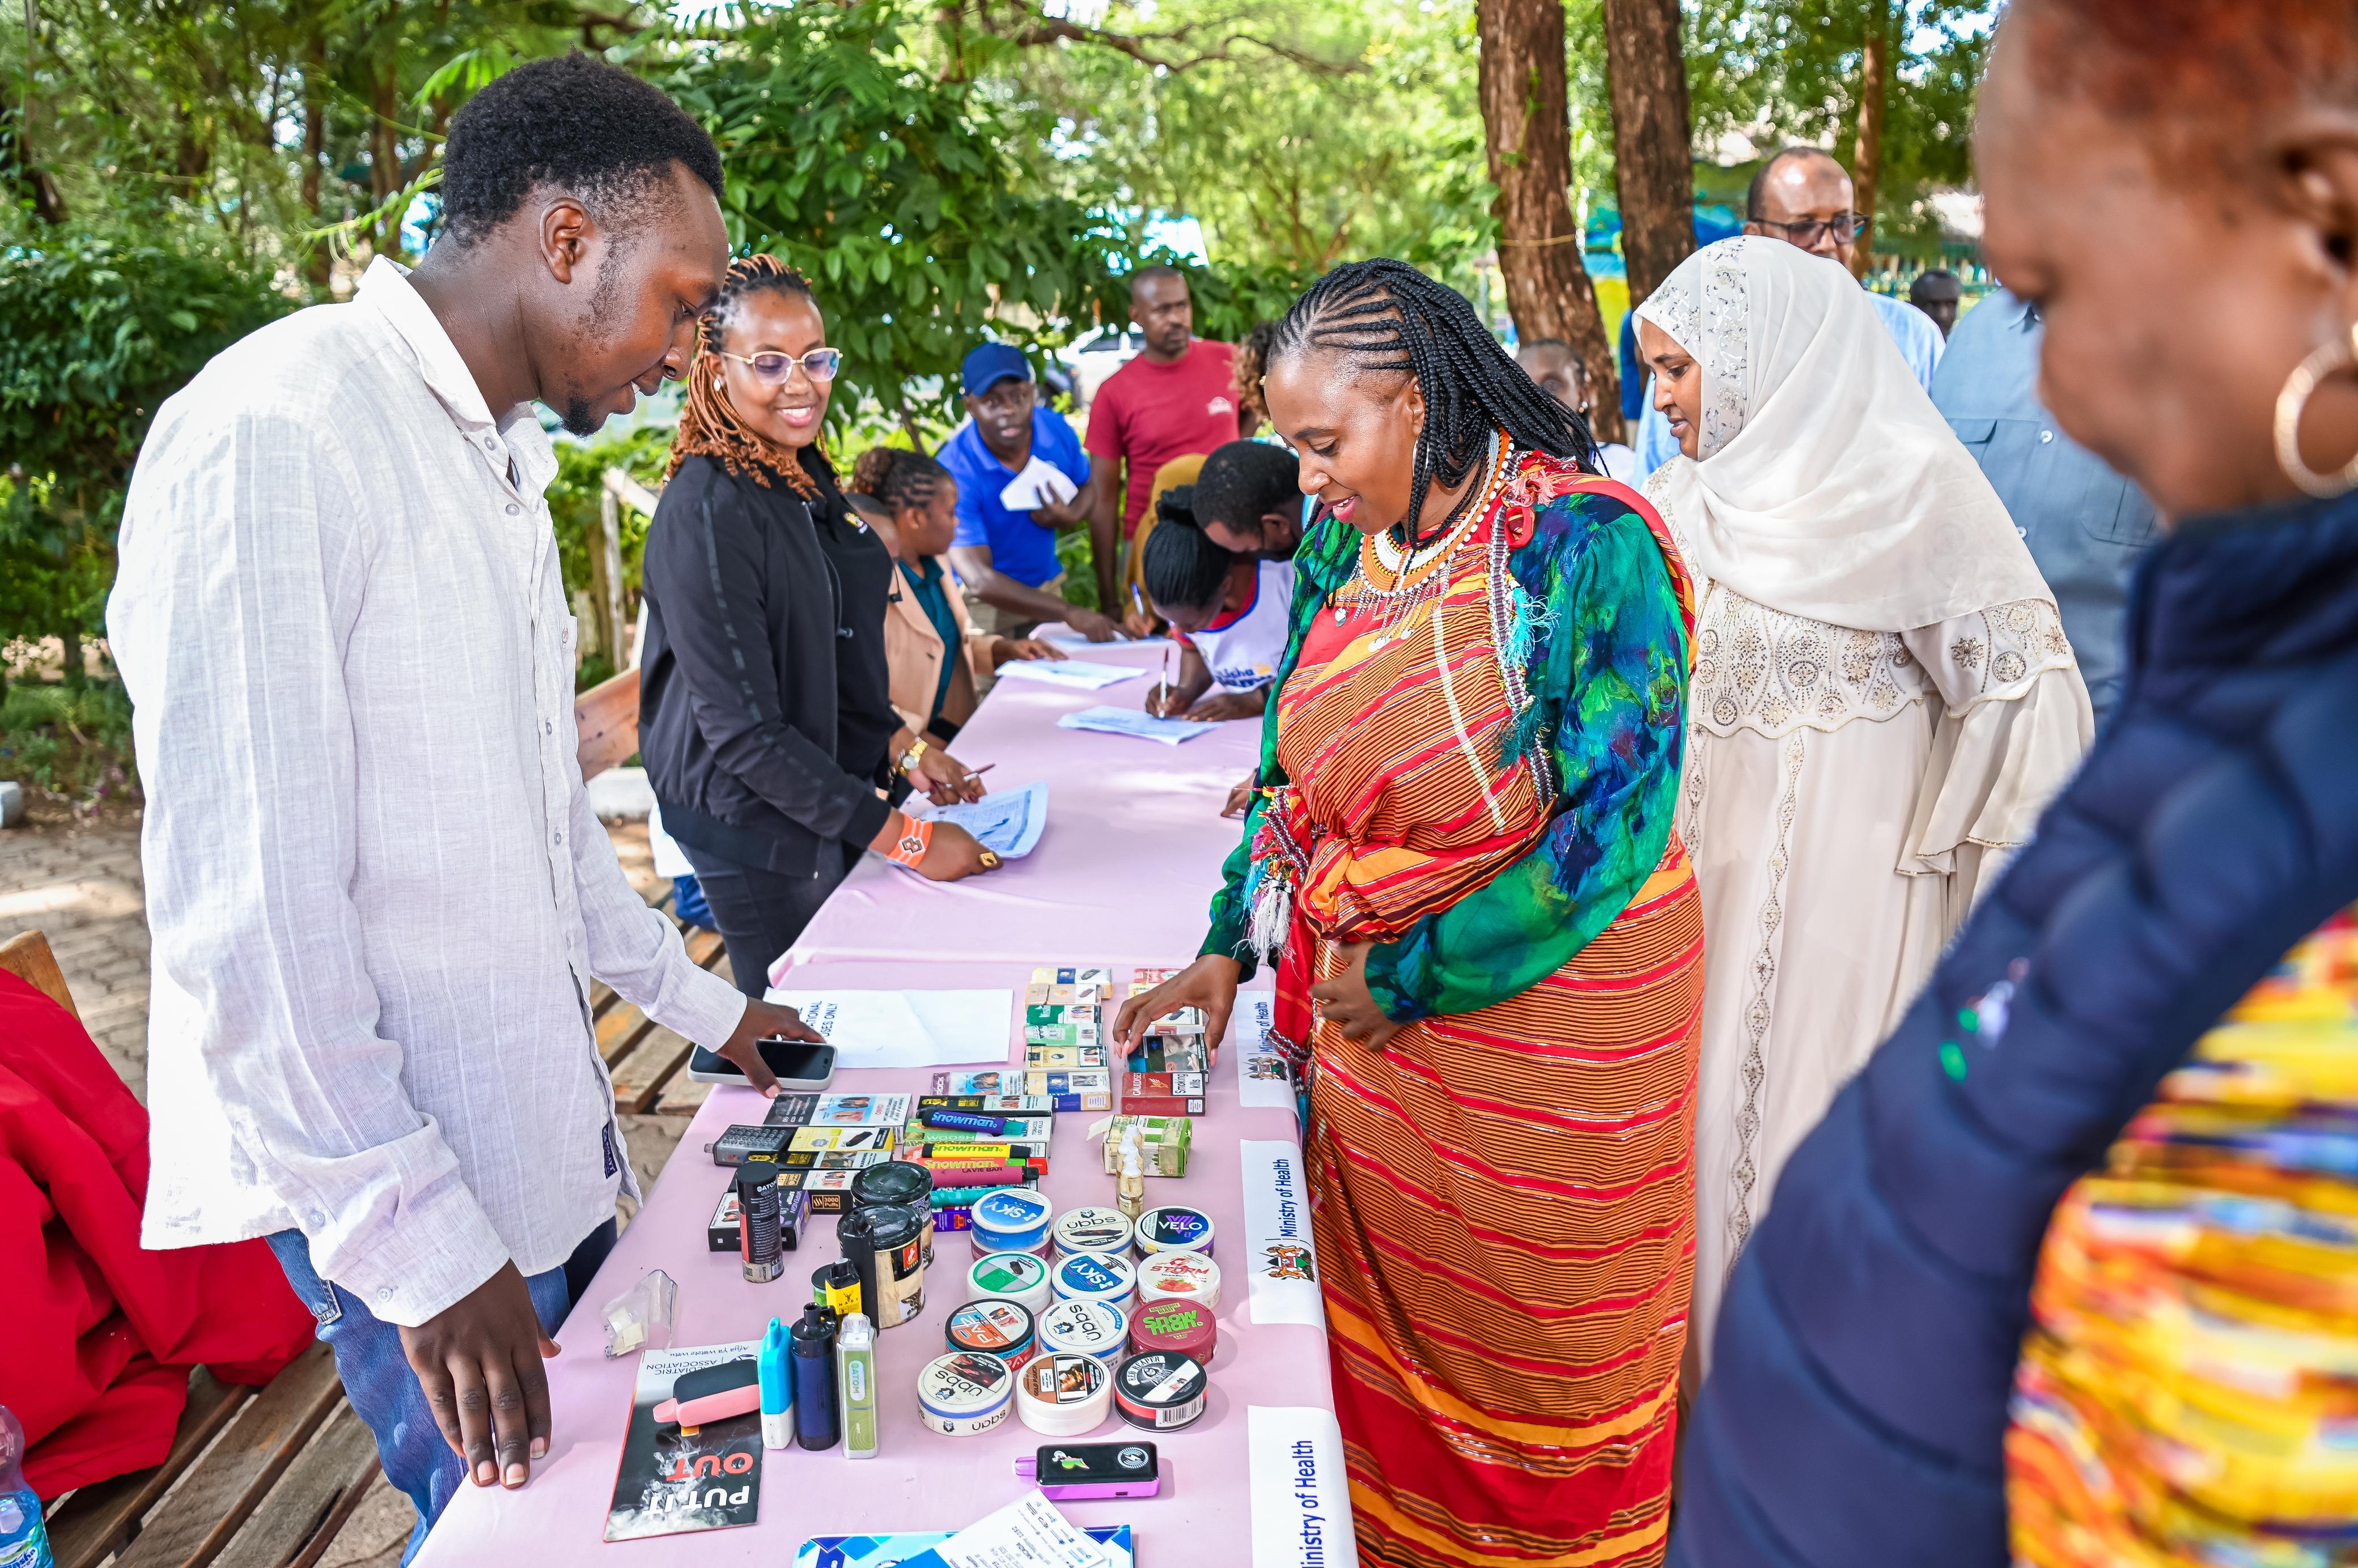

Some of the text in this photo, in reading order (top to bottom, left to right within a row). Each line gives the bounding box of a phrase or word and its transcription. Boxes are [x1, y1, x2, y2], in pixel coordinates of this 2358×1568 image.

[825, 1002, 838, 1019] ONLY
[1254, 1001, 1269, 1019] Health
[1175, 1074, 1188, 1093] Smoking
[1190, 1080, 1201, 1088] kills
[932, 1112, 994, 1128] Snowman
[924, 1160, 995, 1170] Snowman
[1273, 1159, 1298, 1238] Ministry of Health
[983, 1201, 1025, 1217] SKY
[1159, 1221, 1203, 1230] VELO
[1069, 1263, 1107, 1284] SKY
[1150, 1265, 1210, 1276] STORM
[647, 1359, 717, 1370] ASSOCIATION
[1134, 1355, 1161, 1371] REAPER
[666, 1452, 754, 1482] OUT
[642, 1485, 750, 1515] PUT IT
[1291, 1440, 1326, 1568] inistry of Health
